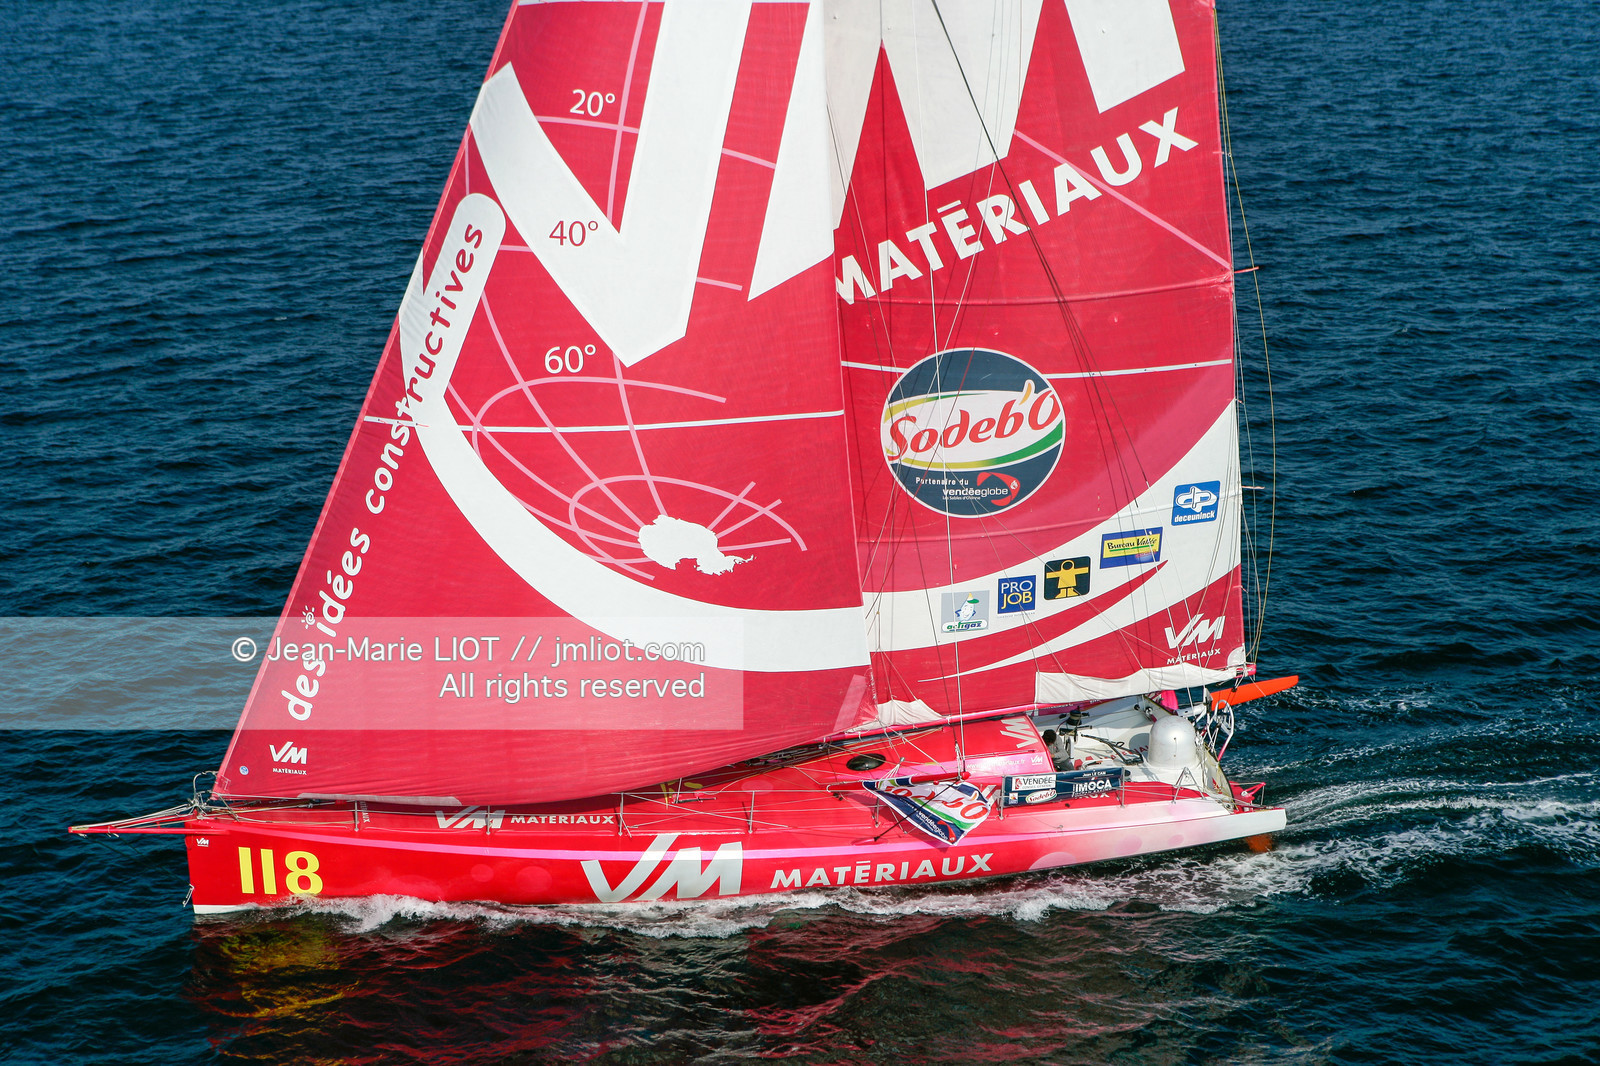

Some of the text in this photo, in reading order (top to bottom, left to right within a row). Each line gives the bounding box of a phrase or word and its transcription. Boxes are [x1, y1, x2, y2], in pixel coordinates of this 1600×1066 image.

[281, 222, 483, 721] des idées constructives
[959, 478, 969, 486] du
[1174, 511, 1215, 523] deceuninck
[1106, 541, 1135, 550] Bureau
[1001, 580, 1033, 594] PRO
[1001, 591, 1033, 610] JOB
[1164, 612, 1226, 649] VM
[269, 741, 308, 764] VM
[435, 805, 506, 829] VM
[238, 845, 324, 895] 118
[580, 832, 744, 903] VM
